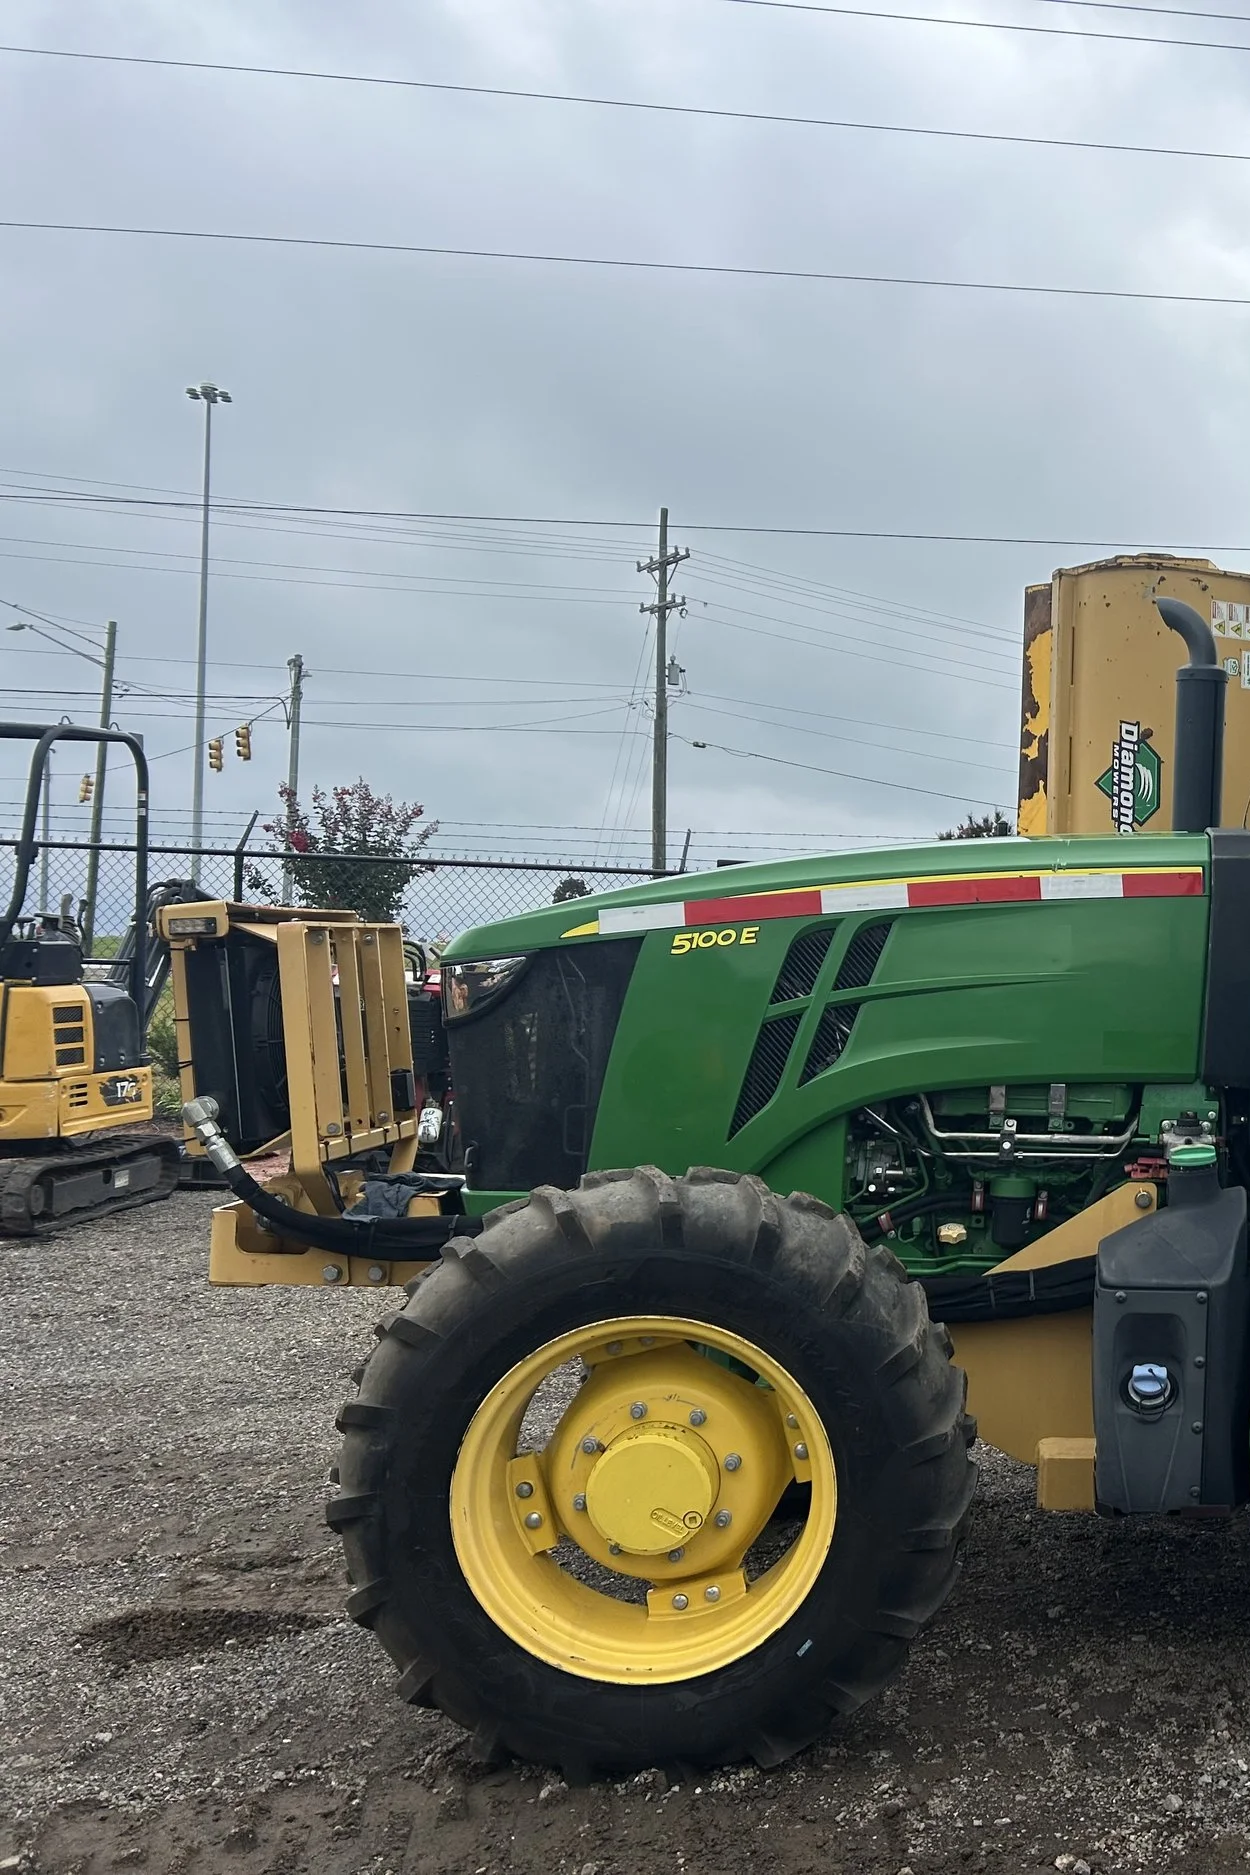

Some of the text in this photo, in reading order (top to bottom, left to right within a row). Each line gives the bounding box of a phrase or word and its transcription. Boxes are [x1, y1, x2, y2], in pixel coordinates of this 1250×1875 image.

[1112, 743, 1120, 819] MOWERS
[670, 926, 760, 955] 5100 E
